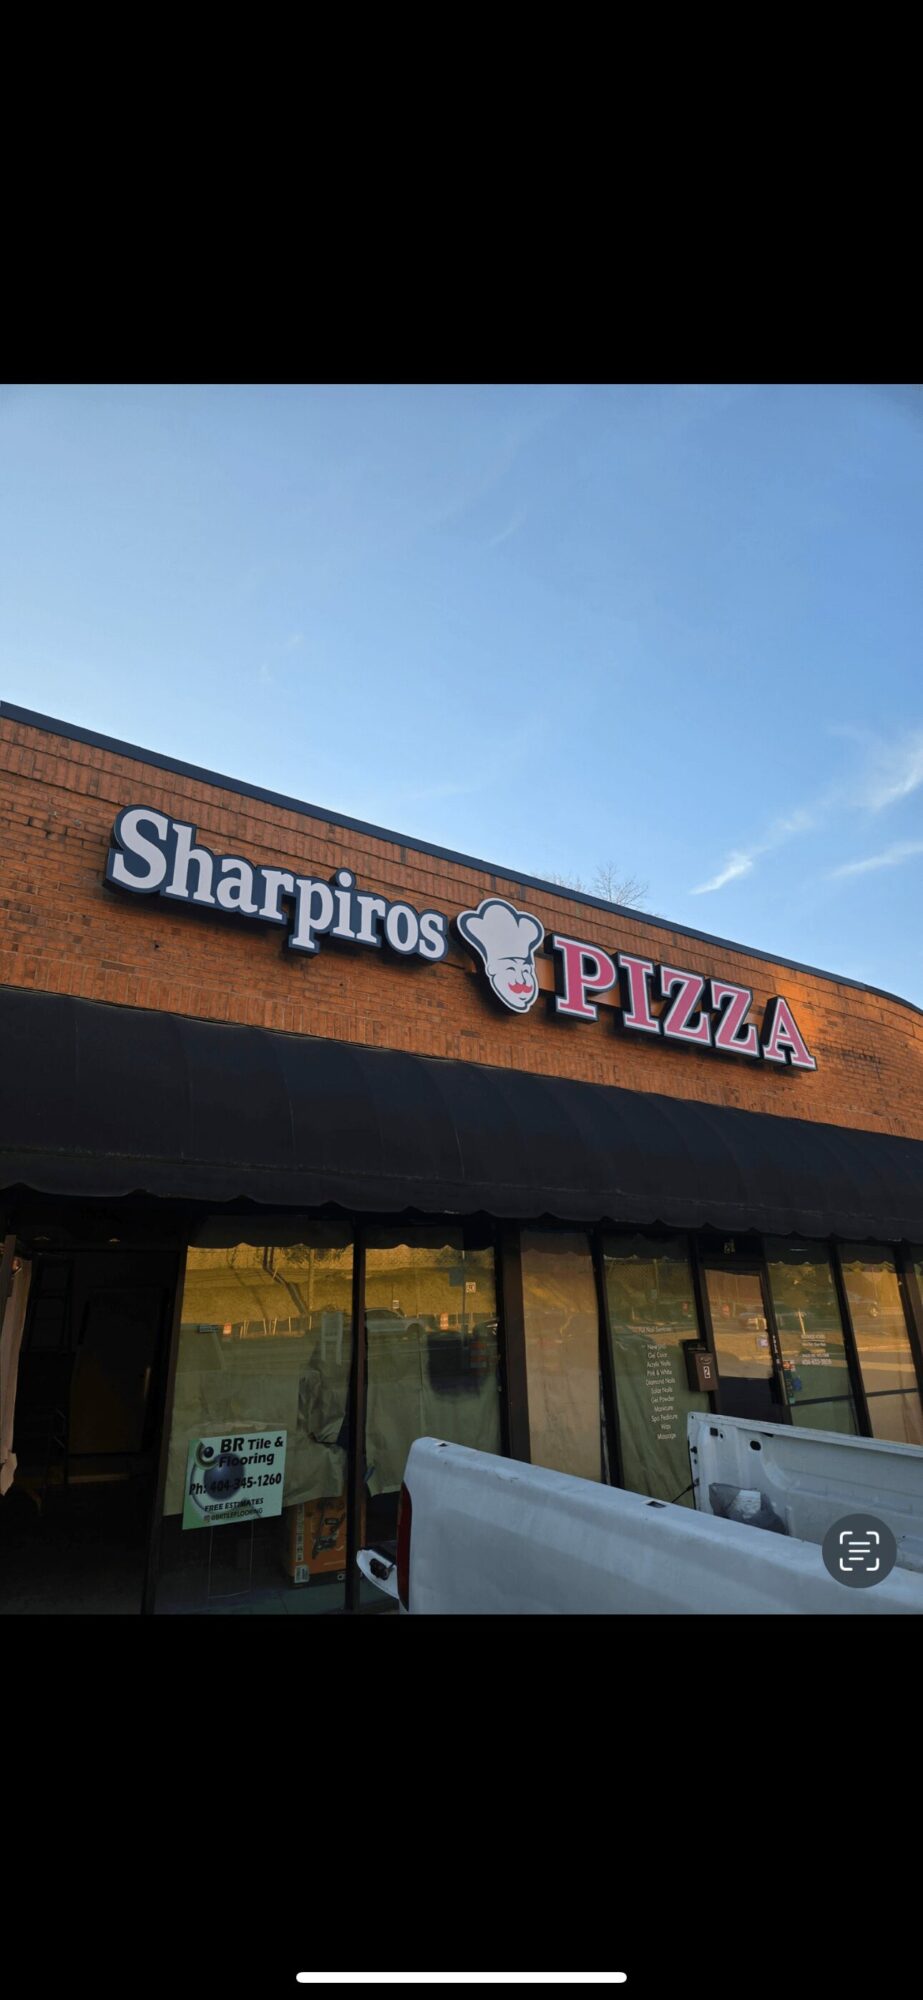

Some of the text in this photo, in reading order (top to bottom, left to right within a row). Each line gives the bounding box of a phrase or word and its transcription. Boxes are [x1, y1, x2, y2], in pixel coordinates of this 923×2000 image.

[110, 804, 817, 1071] Sharpiros PIZZA
[220, 1436, 284, 1454] BR Tile &
[218, 1452, 275, 1468] Flooring
[188, 1472, 282, 1496] Ph: 404-345-1260
[204, 1497, 264, 1512] FREE ESTIMATES
